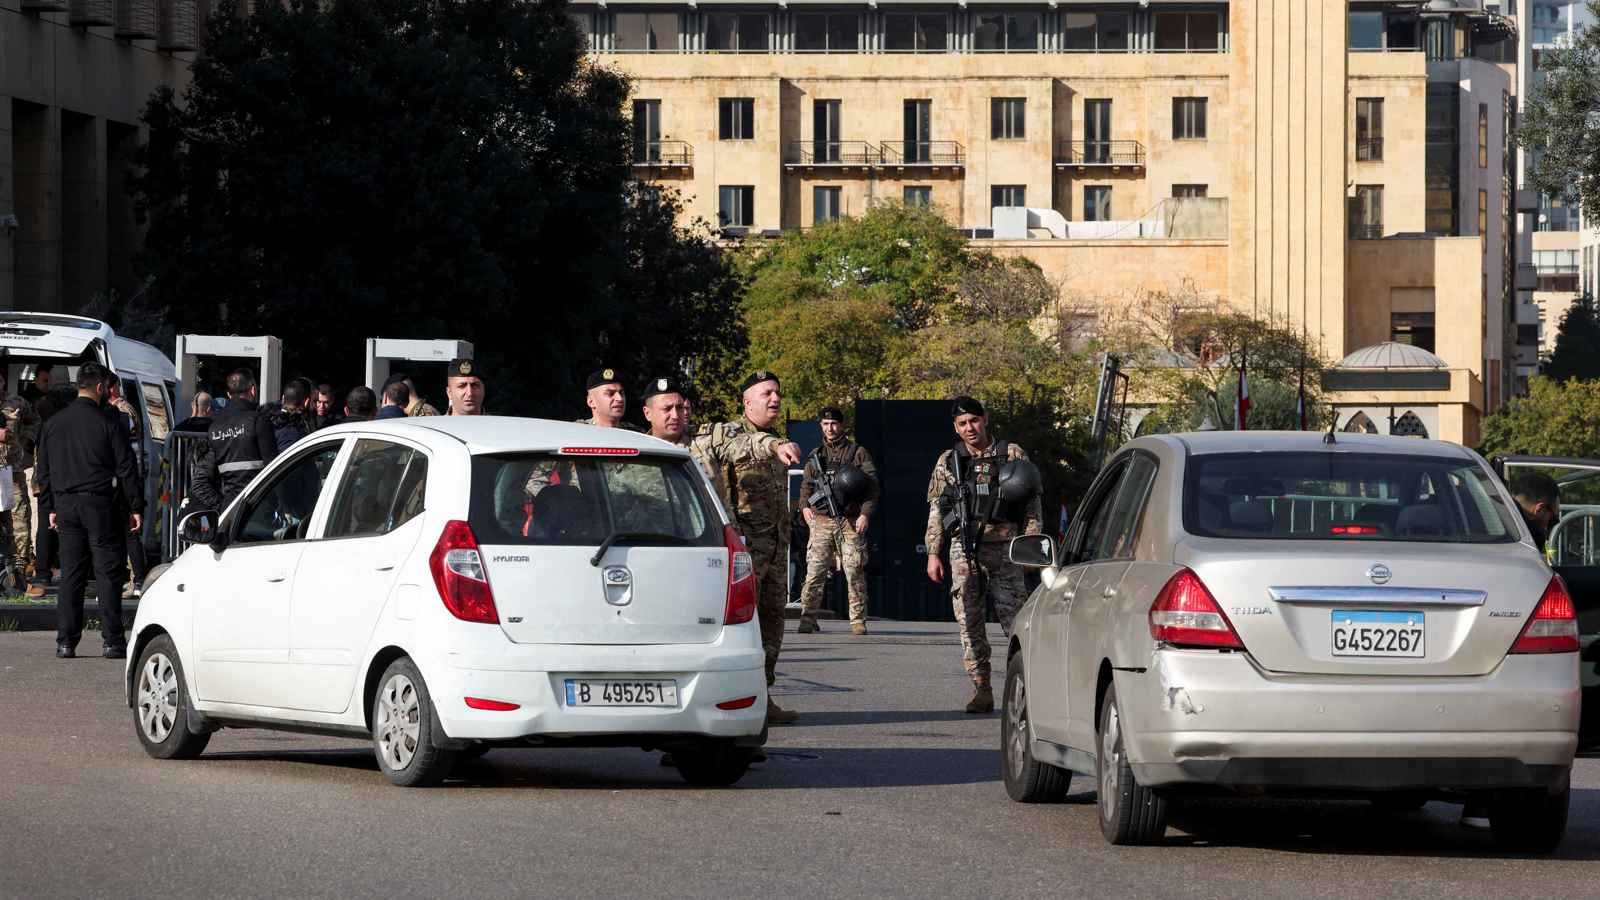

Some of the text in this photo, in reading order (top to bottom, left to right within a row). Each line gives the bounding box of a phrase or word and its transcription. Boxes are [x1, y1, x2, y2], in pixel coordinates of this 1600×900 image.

[493, 555, 530, 563] HYUNDAI
[1231, 607, 1273, 615] TIIDA
[1334, 628, 1422, 652] G452267
[579, 682, 664, 704] B 495251
